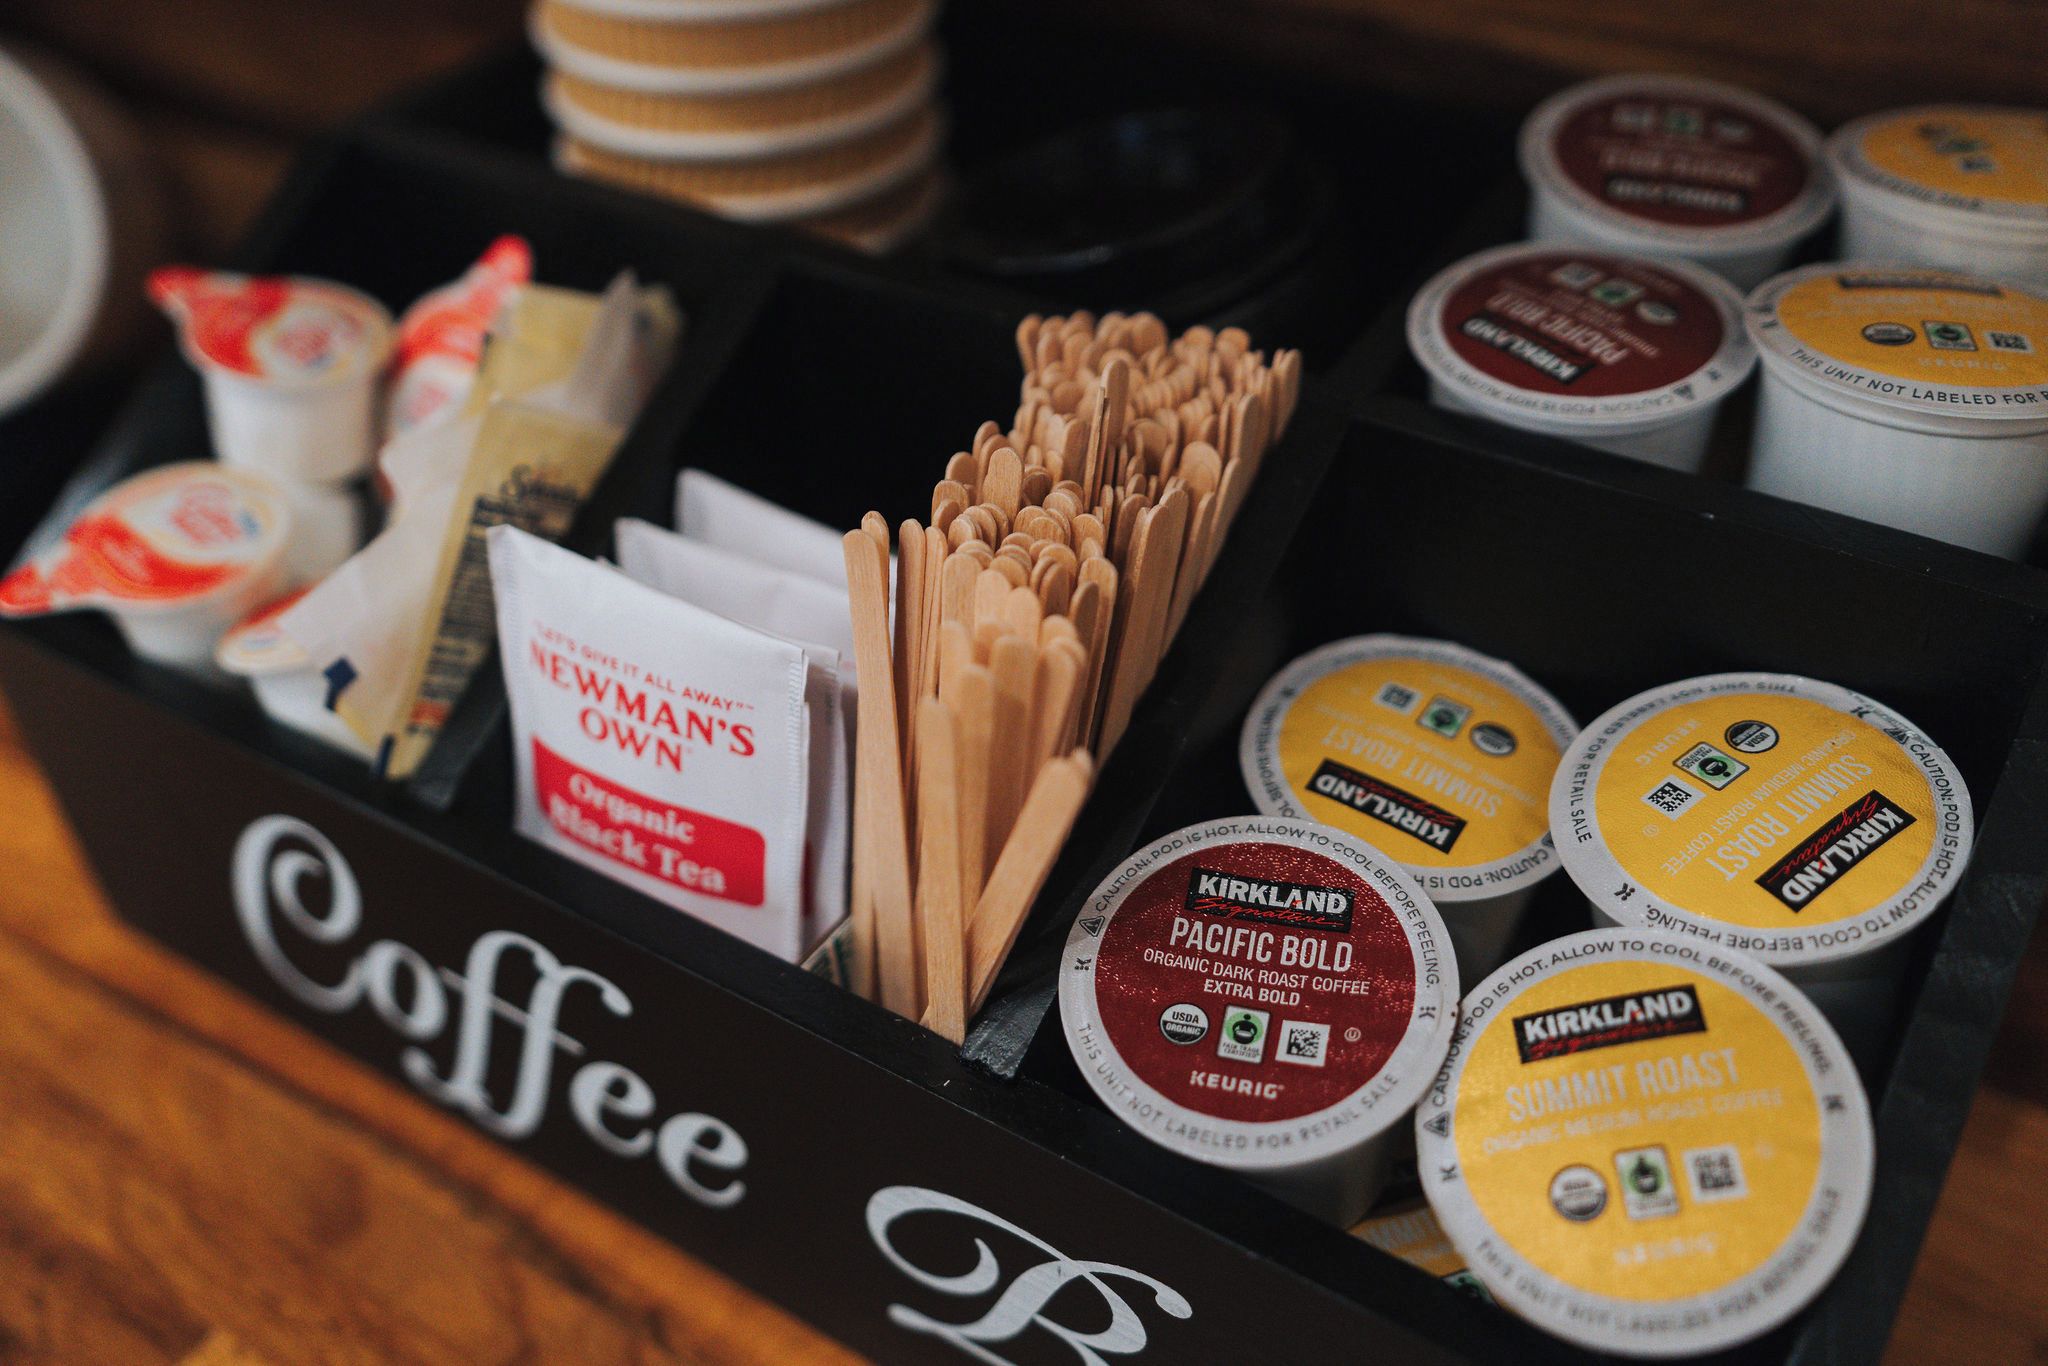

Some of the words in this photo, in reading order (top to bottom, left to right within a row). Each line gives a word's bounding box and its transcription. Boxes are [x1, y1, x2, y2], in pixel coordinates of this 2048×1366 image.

[1789, 349, 1824, 368] THIS
[1824, 364, 1865, 384] UNIT
[1867, 378, 1906, 396] NOT
[1912, 387, 1997, 406] LABELED
[2002, 391, 2039, 405] FOR
[581, 643, 619, 671] GIVE
[623, 661, 640, 679] IT
[644, 672, 676, 694] ALL
[529, 638, 756, 758] NEWMAN'S
[578, 706, 684, 774] OWN
[1587, 736, 1608, 761] FOR
[1744, 731, 1771, 748] USDA
[1402, 758, 1506, 819] SUMMIT
[1569, 763, 1591, 807] RETAIL
[1750, 761, 1806, 802] MEDIUM
[1775, 753, 1872, 825] SUMMIT
[1910, 743, 1953, 801] CAUTION:
[568, 772, 696, 844] Organic
[1315, 773, 1452, 848] KIRKLAND
[1570, 807, 1593, 844] SALE
[1711, 794, 1757, 839] ROAST
[1942, 803, 1960, 836] POD
[547, 793, 649, 869] Black
[652, 841, 727, 893] Tea
[1660, 831, 1715, 877] COFFEE
[1705, 810, 1790, 881] ROAST
[1767, 793, 1879, 884] Signature
[1781, 806, 1904, 903] KIRKLAND
[1943, 836, 1959, 848] IS
[1428, 875, 1445, 889] IS
[1450, 874, 1484, 889] POD
[1484, 850, 1549, 885] CAUTION:
[1929, 848, 1956, 880] HOT.
[1095, 859, 1152, 914] CAUTION:
[1150, 836, 1183, 862] POD
[1183, 829, 1202, 843] IS
[1204, 824, 1243, 840] HOT.
[1244, 823, 1306, 840] ALLOW
[1307, 832, 1331, 848] TO
[1331, 841, 1374, 875] COOL
[1373, 867, 1423, 925] BEFORE
[1412, 918, 1441, 989] PEELING.
[1194, 894, 1344, 928] Signature
[1197, 873, 1349, 916] KIRKLAND
[1888, 878, 1937, 922] ALLOW
[1168, 916, 1275, 963] PACIFIC
[1279, 935, 1354, 973] BOLD
[1645, 904, 1722, 943] PEELING.
[1725, 932, 1804, 951] BEFORE
[1807, 924, 1863, 949] COOL
[1864, 914, 1892, 933] TO
[1142, 947, 1210, 973] ORGANIC
[1212, 961, 1255, 983] DARK
[1257, 969, 1309, 989] ROAST
[1311, 976, 1371, 996] COFFEE
[1202, 978, 1254, 1001] EXTRA
[1257, 985, 1301, 1007] BOLD
[231, 814, 749, 1207] Coffee
[1164, 1022, 1202, 1036] ORGANIC
[1171, 1011, 1200, 1025] USDA
[1432, 1024, 1470, 1108] CAUTION:
[1463, 995, 1496, 1032] POD
[1493, 980, 1511, 999] IS
[1509, 959, 1550, 988] HOT.
[1551, 940, 1615, 966] ALLOW
[1620, 939, 1644, 952] TO
[1649, 941, 1702, 964] COOL
[1707, 956, 1777, 1002] BEFORE
[1523, 990, 1693, 1044] KIRKLAND
[1076, 1022, 1099, 1061] THIS
[1096, 1061, 1130, 1097] UNIT
[1127, 1095, 1163, 1125] NOT
[1165, 1117, 1248, 1149] LABELED
[1255, 1135, 1293, 1149] FOR
[1301, 1106, 1360, 1141] RETAIL
[1360, 1072, 1400, 1109] SALE
[1189, 1070, 1280, 1100] KEURIG
[1504, 1063, 1628, 1122] SUMMIT
[1635, 1047, 1741, 1098] ROAST
